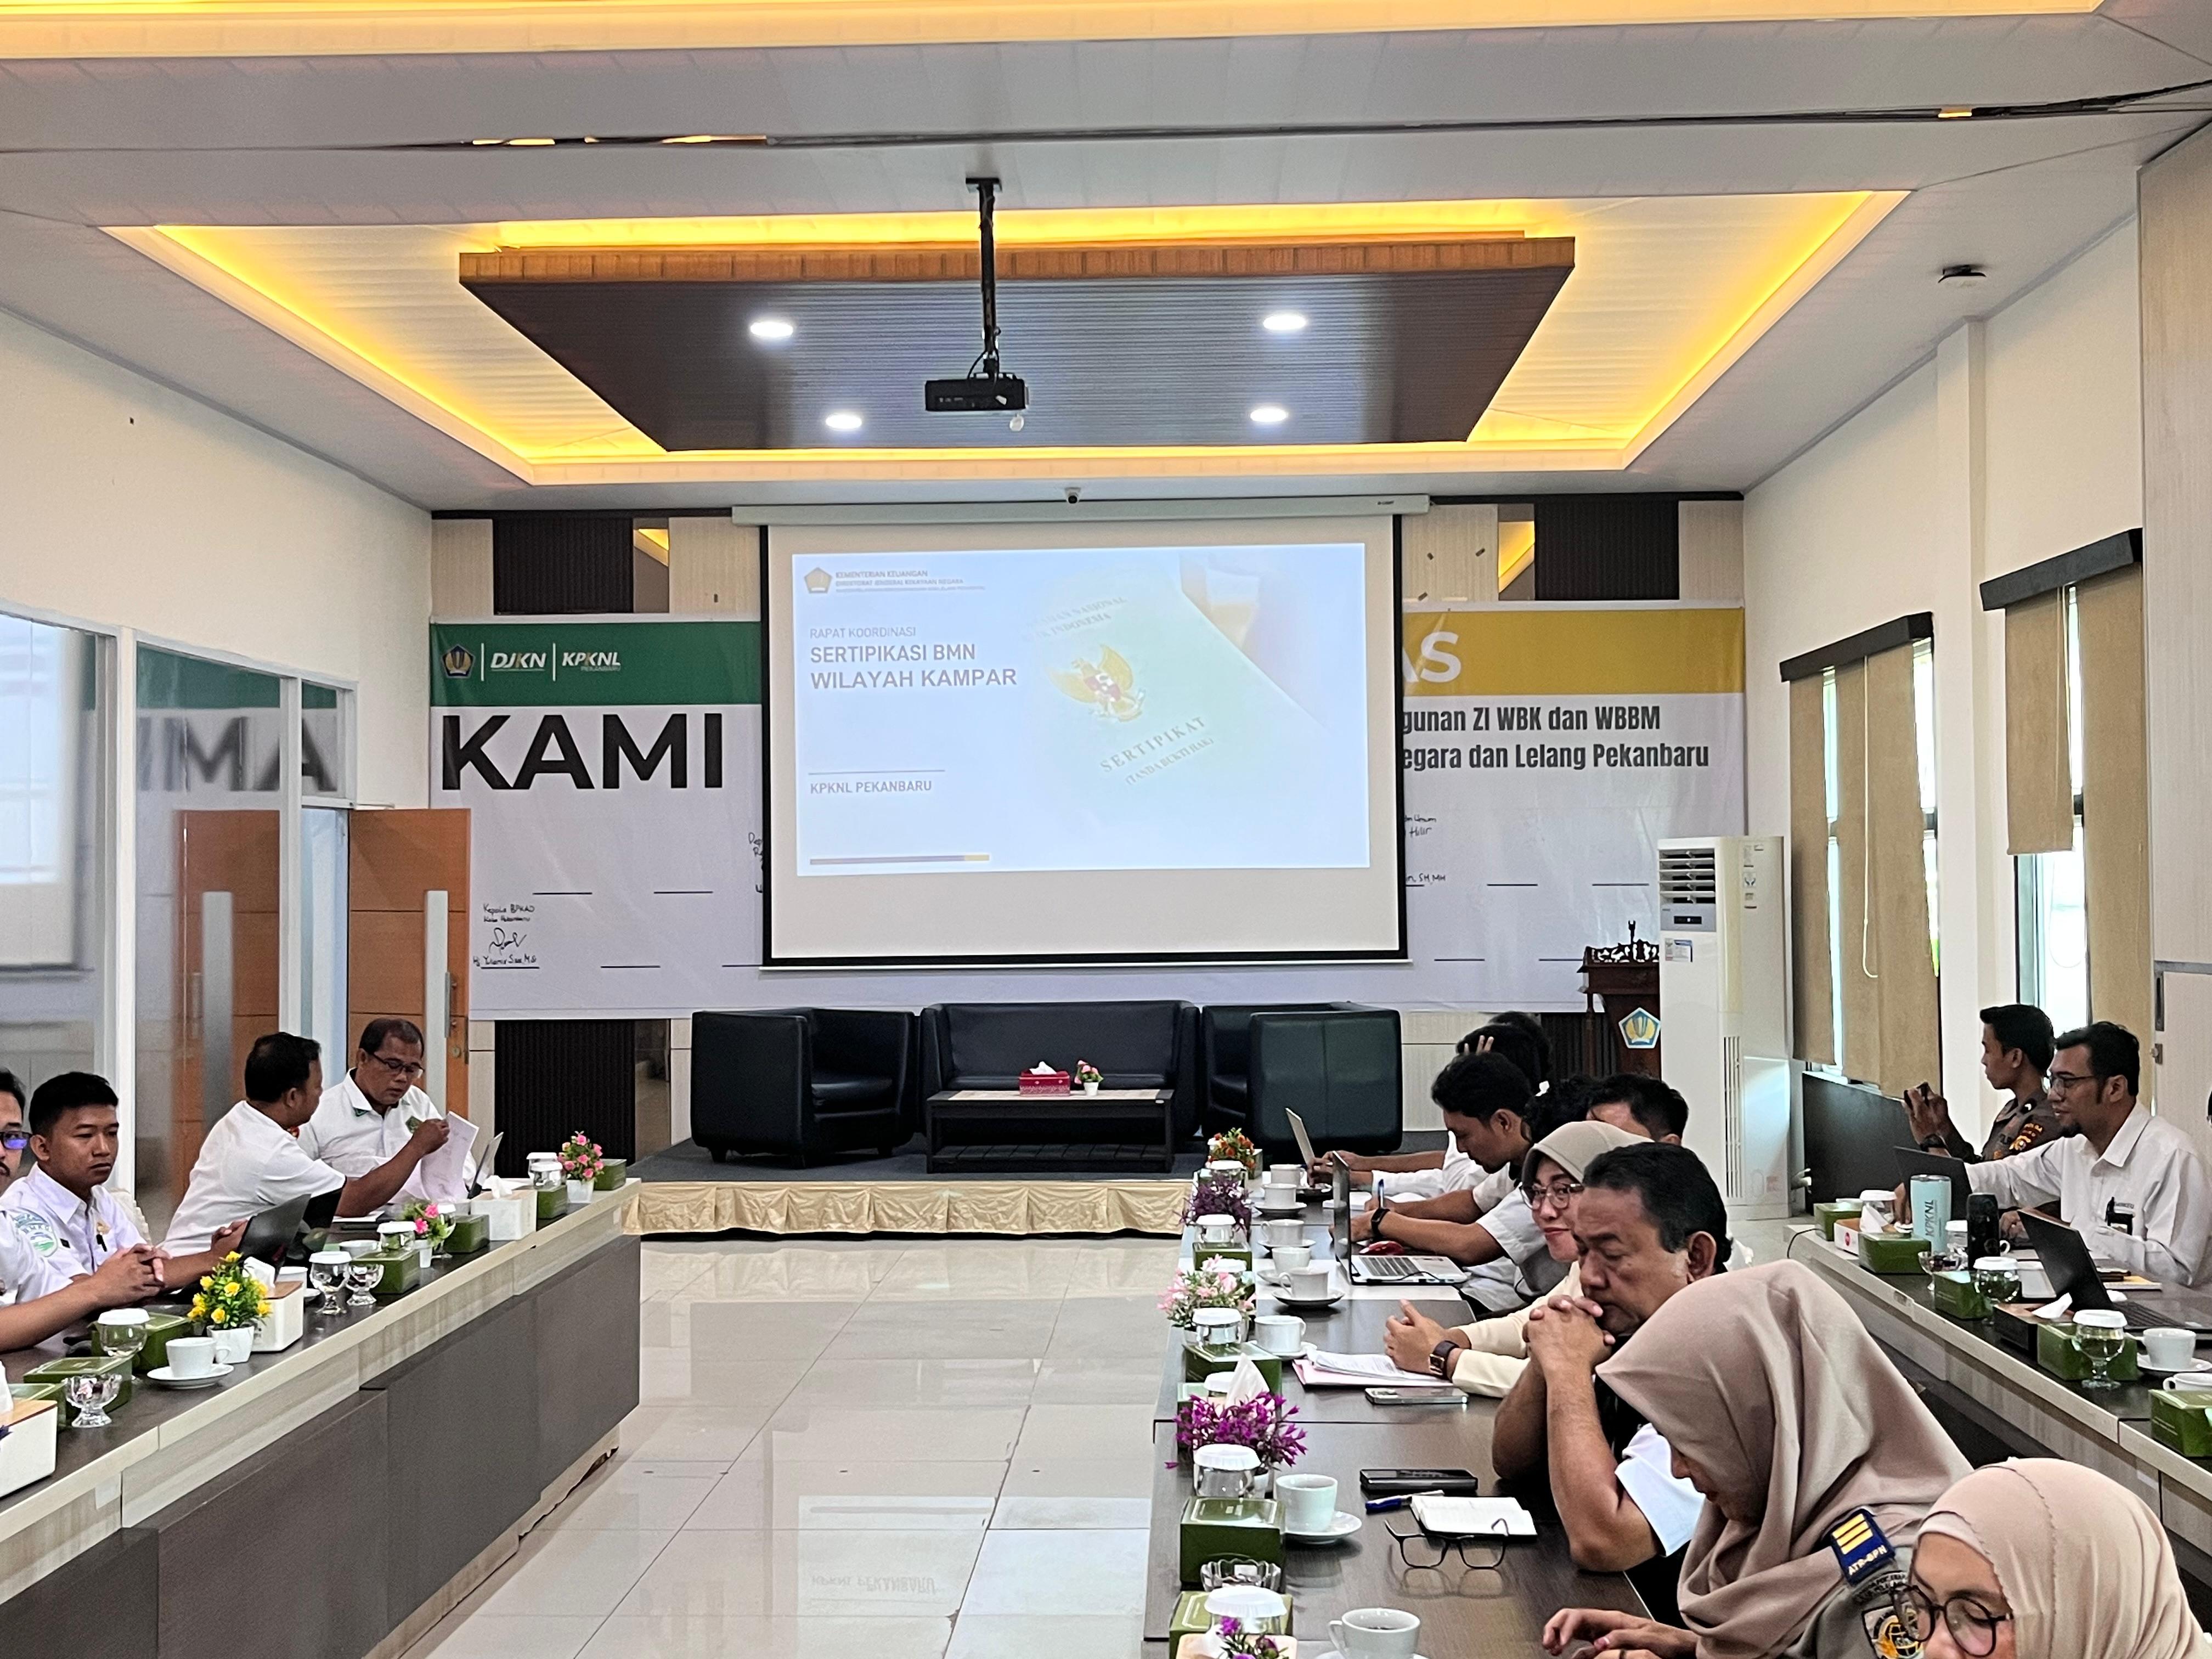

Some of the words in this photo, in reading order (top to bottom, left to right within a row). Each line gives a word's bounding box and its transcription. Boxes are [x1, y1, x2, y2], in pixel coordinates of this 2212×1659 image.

[810, 628, 845, 639] RAPAT
[848, 627, 916, 638] KOORDINASI
[490, 652, 547, 668] DJKN
[562, 652, 621, 666] KPKNL
[810, 644, 927, 663] SERTIPIKASI
[933, 644, 975, 661] BMN
[810, 670, 913, 690] WILAYAH
[921, 668, 1017, 687] KAMPAR
[1473, 707, 1490, 731] ZI
[1497, 707, 1542, 731] WBK
[1548, 706, 1588, 731] dan
[1594, 706, 1661, 730] WBBM
[442, 713, 723, 790] KAMI
[1100, 716, 1206, 772] SERTIPIKAT
[1469, 744, 1508, 768] dan
[1516, 744, 1586, 770] Lelang
[1594, 743, 1709, 767] Pekanbaru
[810, 782, 853, 794] KPKNL
[856, 781, 932, 793] PEKANBARU
[1924, 1199, 1935, 1238] KPKNL
